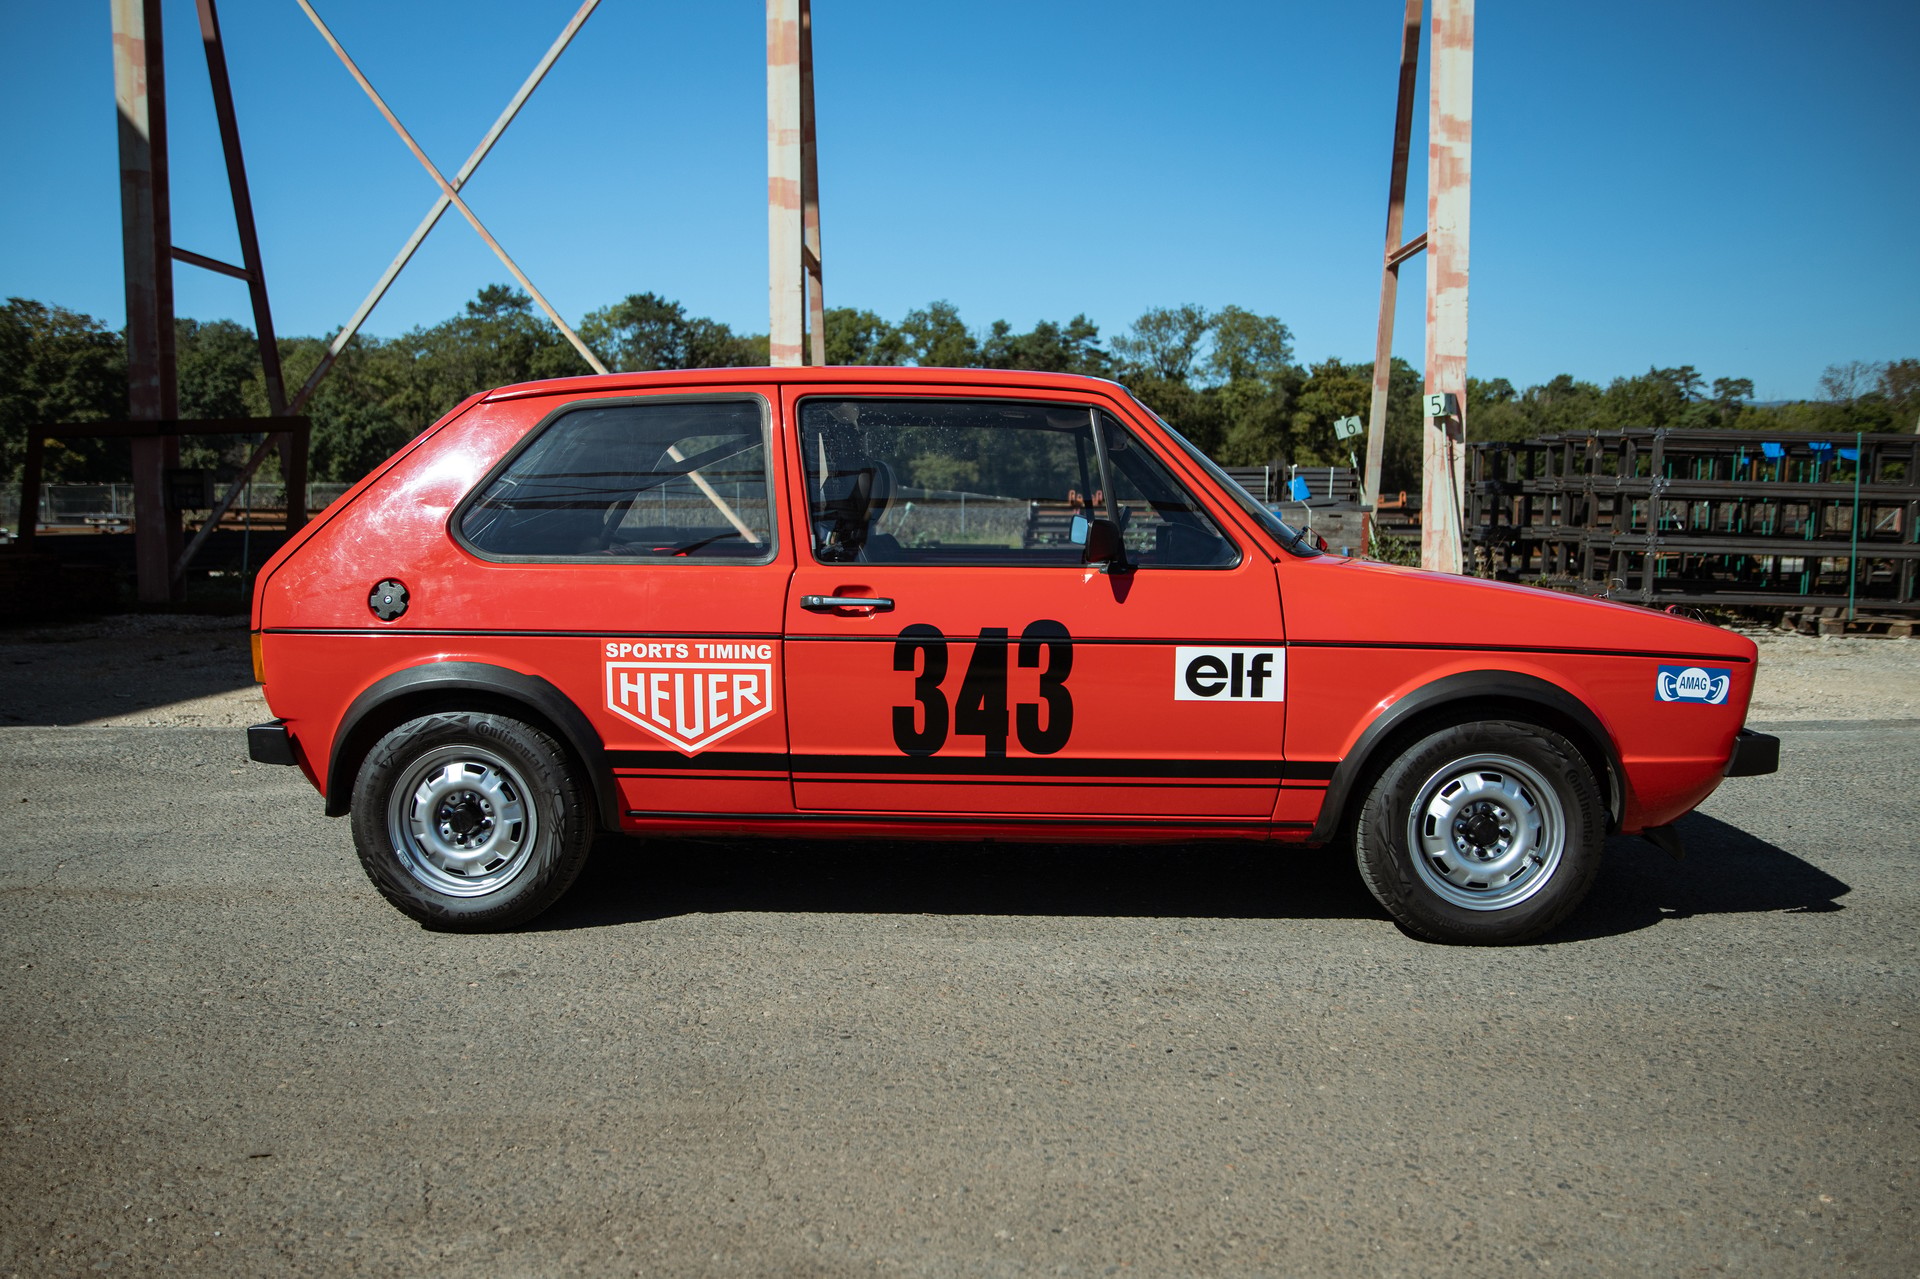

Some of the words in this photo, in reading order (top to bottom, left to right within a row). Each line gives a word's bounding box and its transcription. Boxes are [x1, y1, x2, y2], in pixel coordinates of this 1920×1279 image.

[1346, 418, 1356, 435] 6
[1431, 395, 1441, 416] 5
[605, 643, 689, 659] SPORTS
[694, 644, 772, 660] TIMING
[892, 619, 1074, 757] 343
[1185, 653, 1273, 698] elf
[1679, 676, 1707, 690] AMAG
[620, 672, 762, 740] HEUER
[477, 722, 545, 770] Continental
[1565, 768, 1594, 848] Continental
